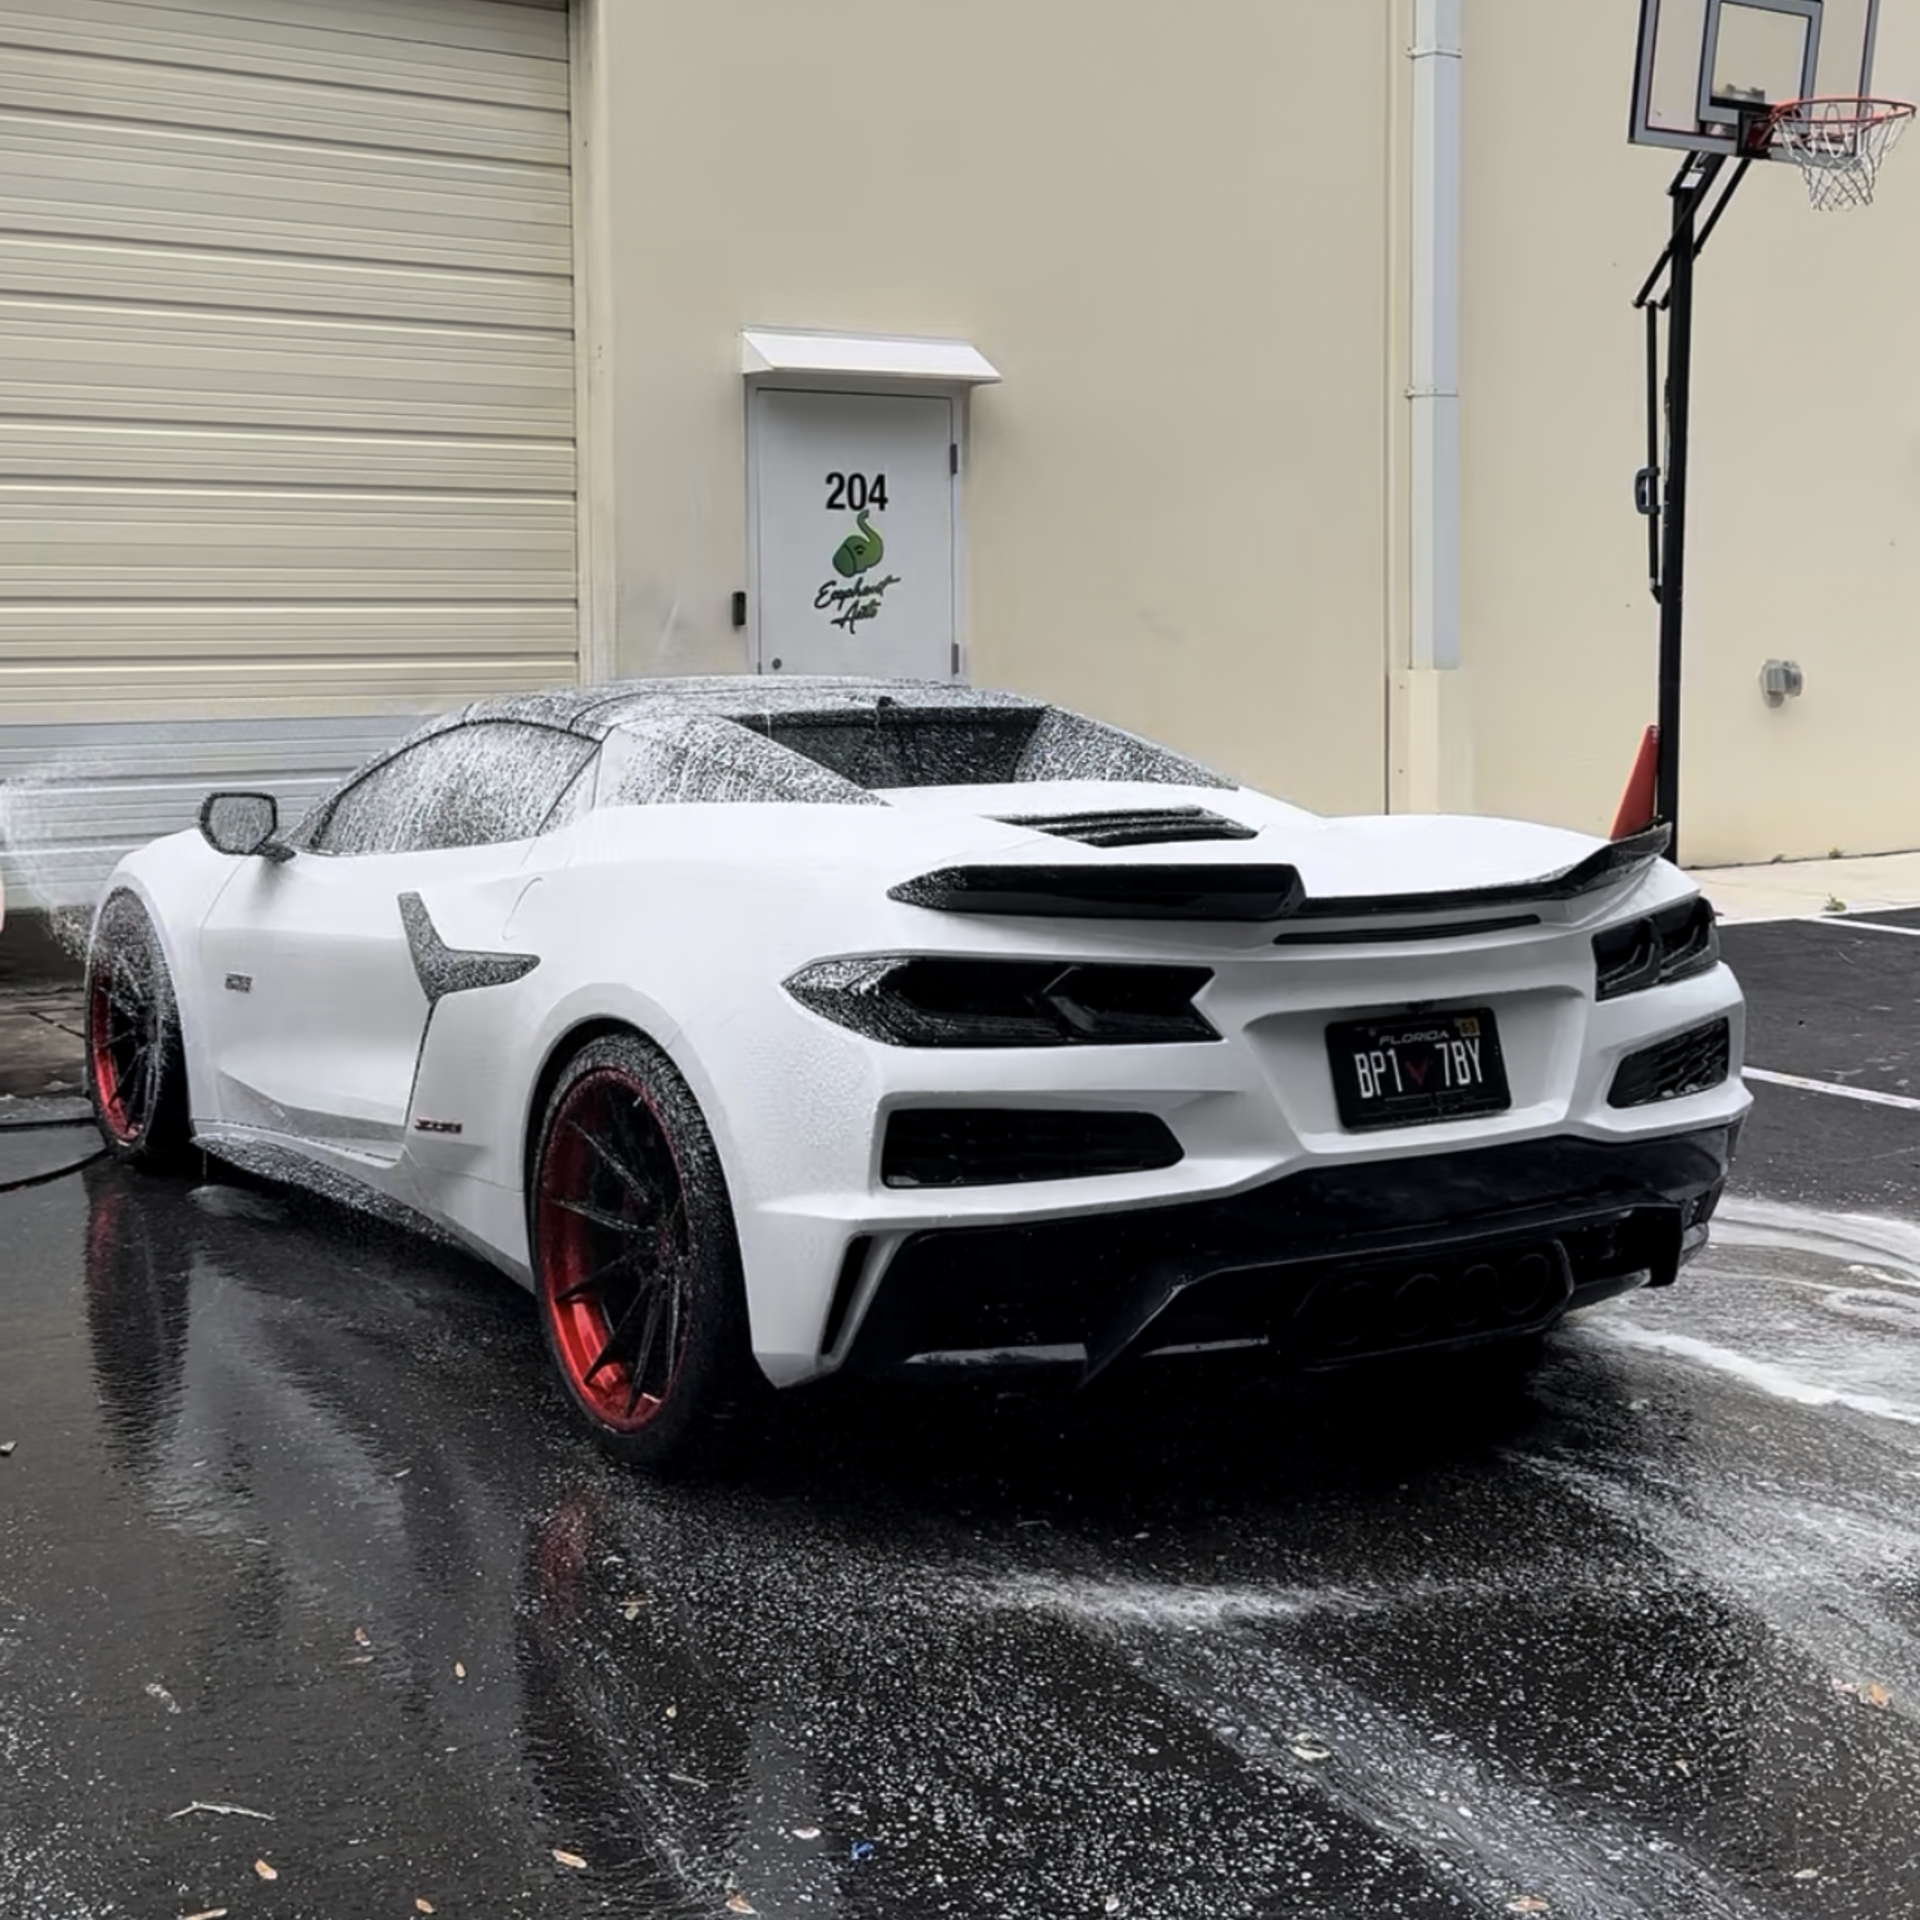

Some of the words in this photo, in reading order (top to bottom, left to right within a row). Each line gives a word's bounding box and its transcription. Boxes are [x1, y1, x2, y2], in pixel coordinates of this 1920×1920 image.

[825, 472, 889, 512] 204
[1379, 1030, 1449, 1046] FLORIDA
[1435, 1038, 1483, 1087] 7BY
